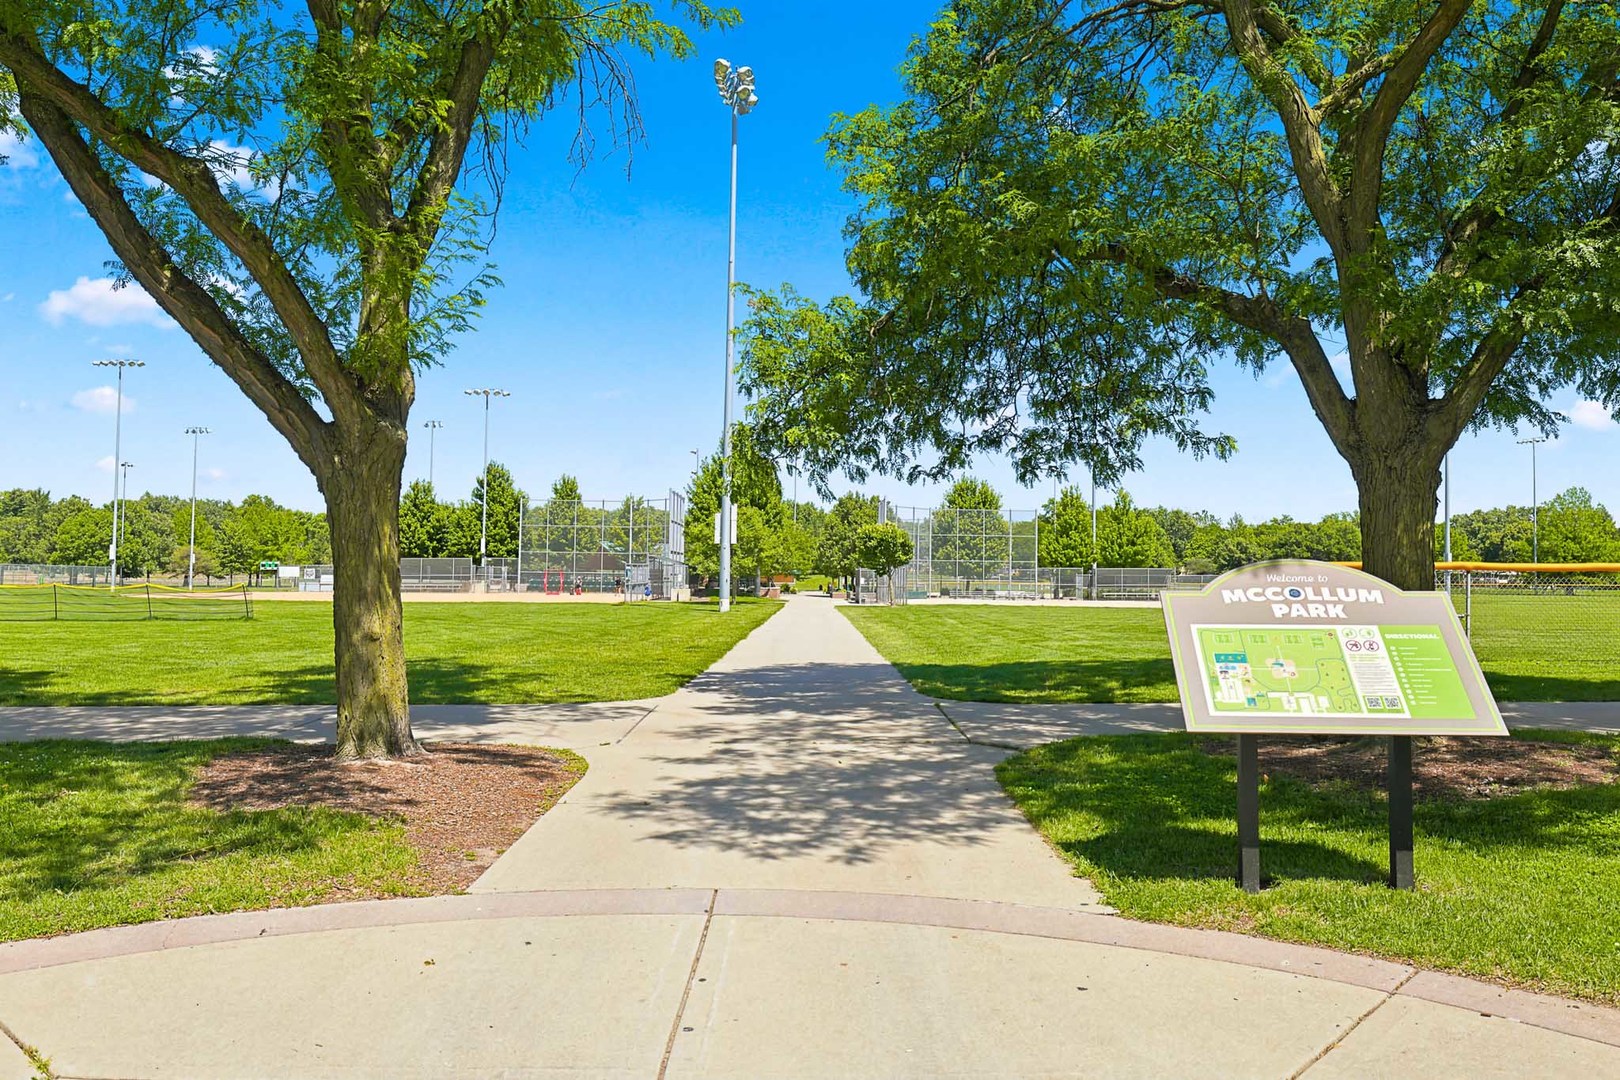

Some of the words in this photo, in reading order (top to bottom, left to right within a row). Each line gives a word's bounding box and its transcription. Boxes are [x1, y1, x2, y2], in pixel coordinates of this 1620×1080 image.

[1266, 574, 1314, 582] Welcome
[1317, 574, 1328, 582] to
[1221, 586, 1384, 604] MCCOLLUM
[1271, 603, 1348, 619] PARK
